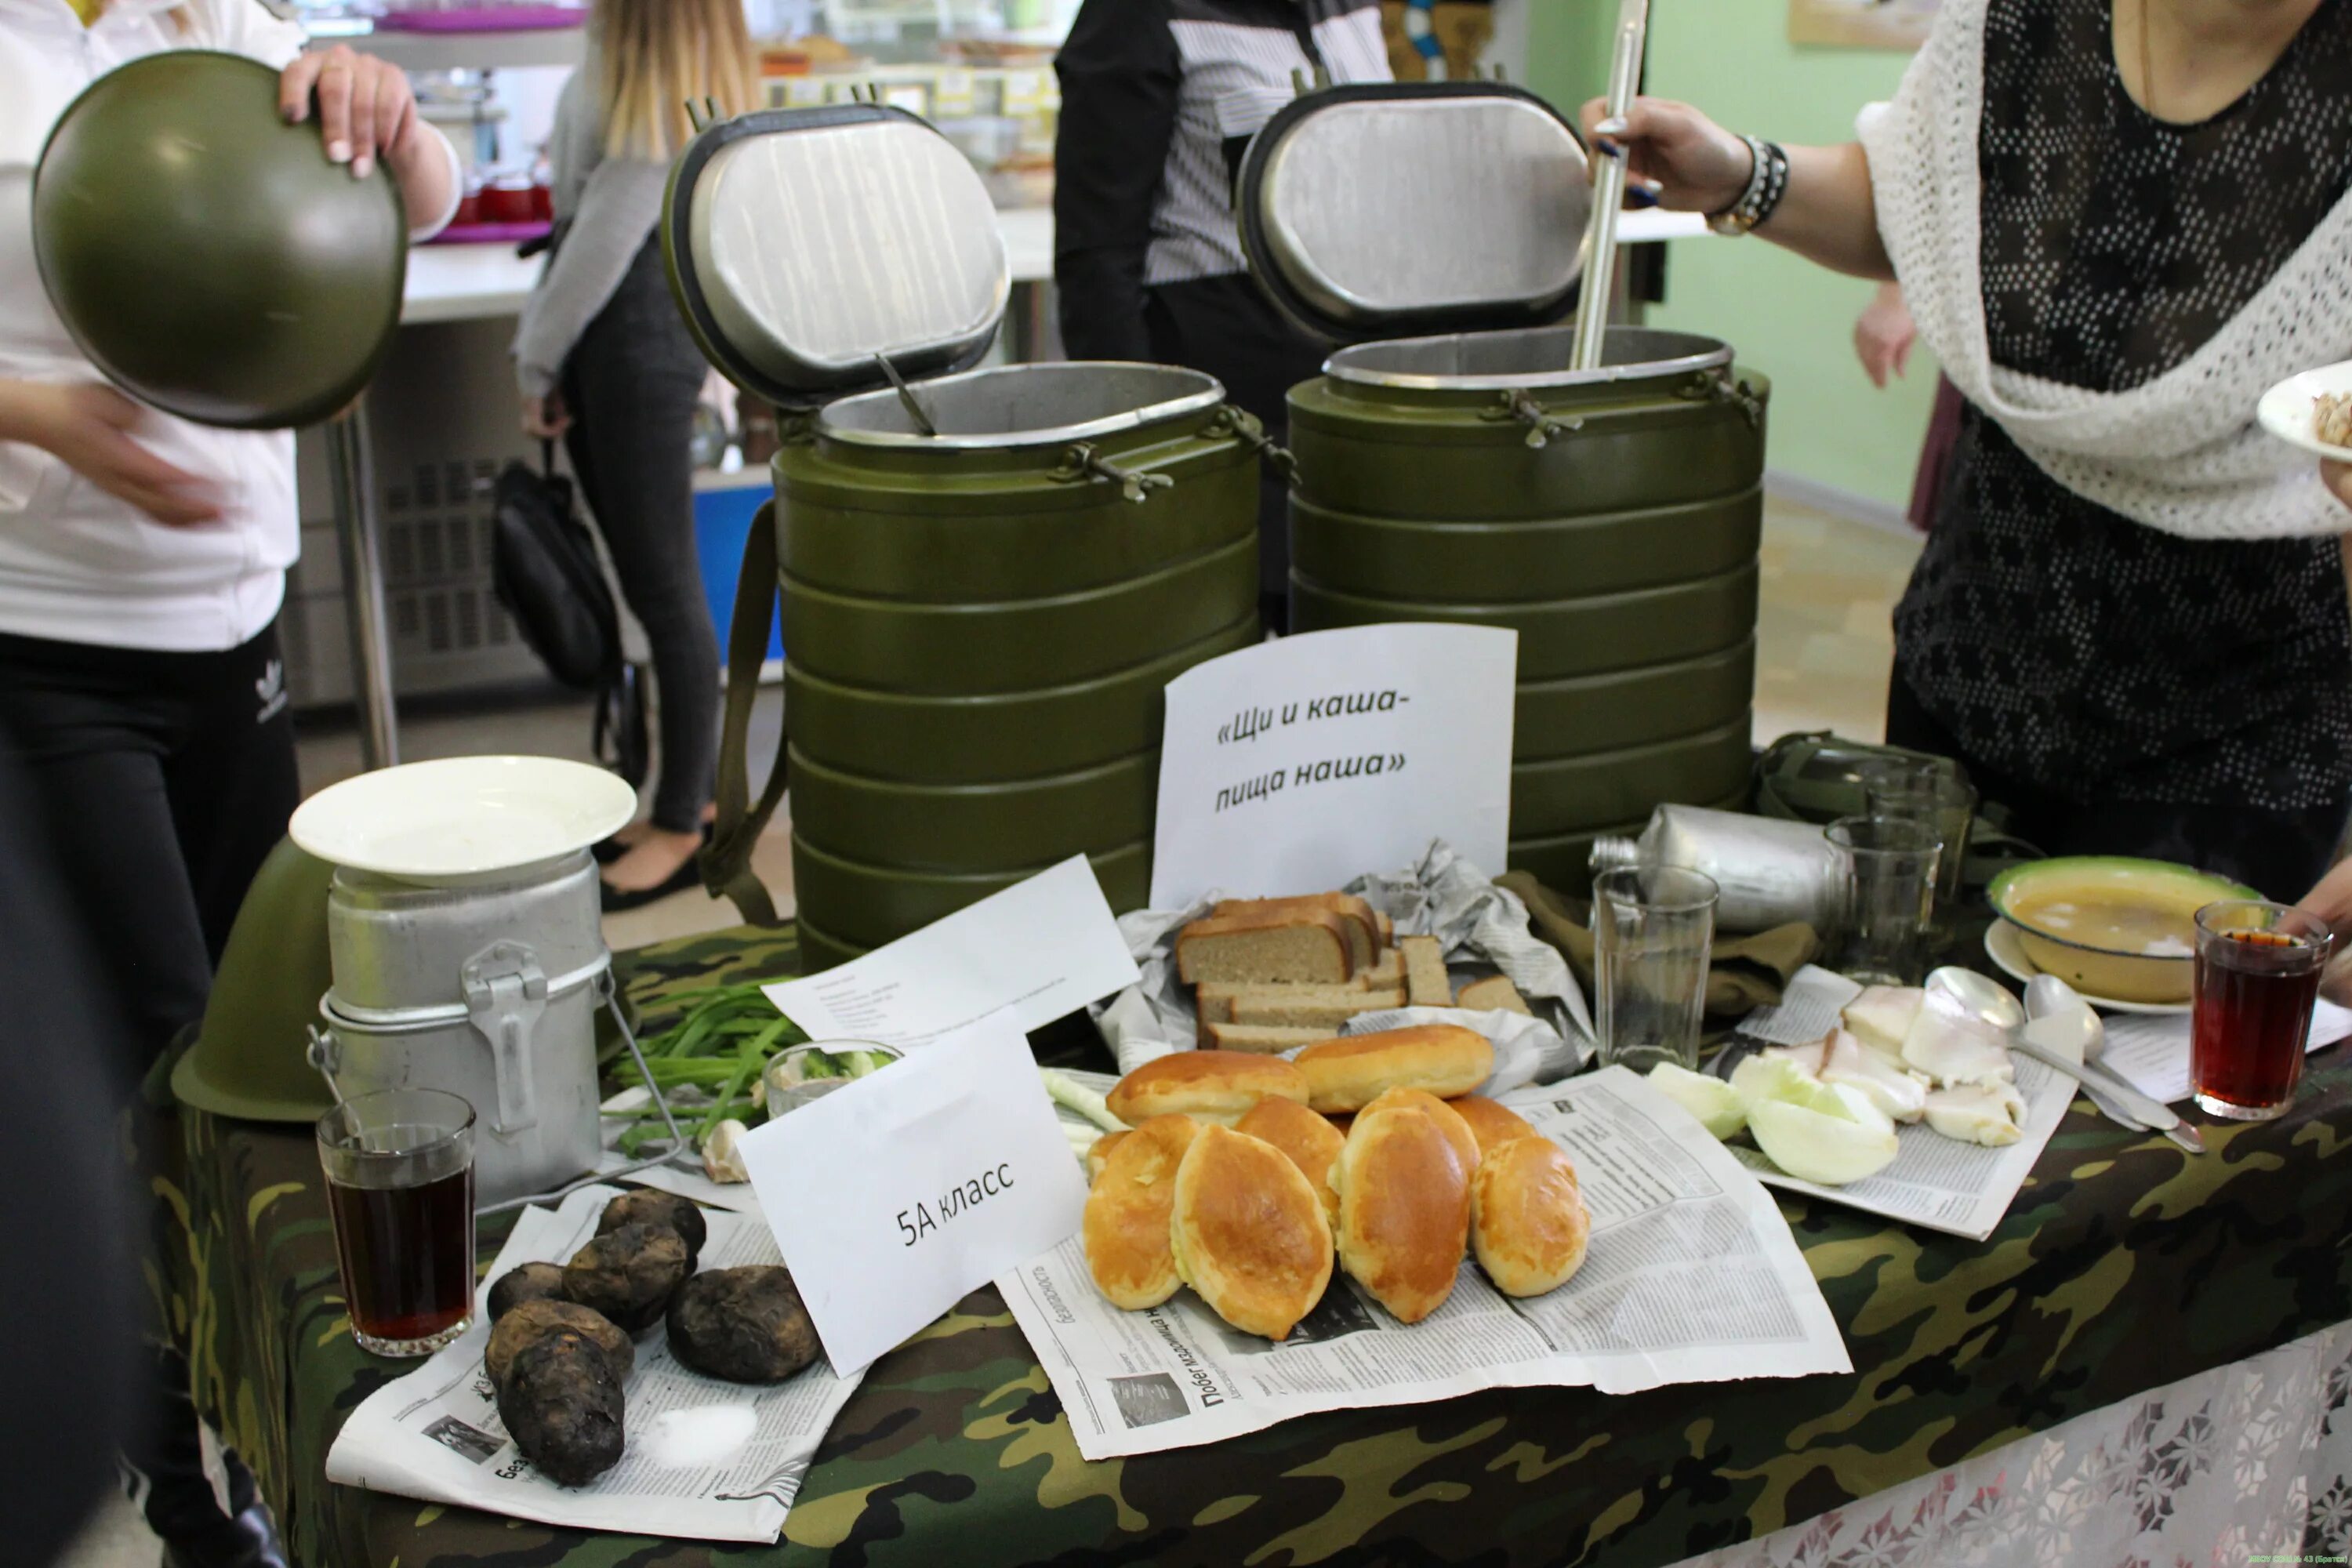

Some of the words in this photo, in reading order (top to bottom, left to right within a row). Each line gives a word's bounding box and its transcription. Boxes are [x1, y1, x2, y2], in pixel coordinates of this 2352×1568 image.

[1218, 706, 1274, 745] «Щи
[1282, 702, 1298, 724] и
[1307, 688, 1410, 721] каша-
[1214, 768, 1287, 813] пища
[1294, 753, 1406, 786] наша»
[897, 1201, 937, 1247] 5А
[938, 1163, 1014, 1223] класс
[1189, 1370, 1224, 1407] Побег
